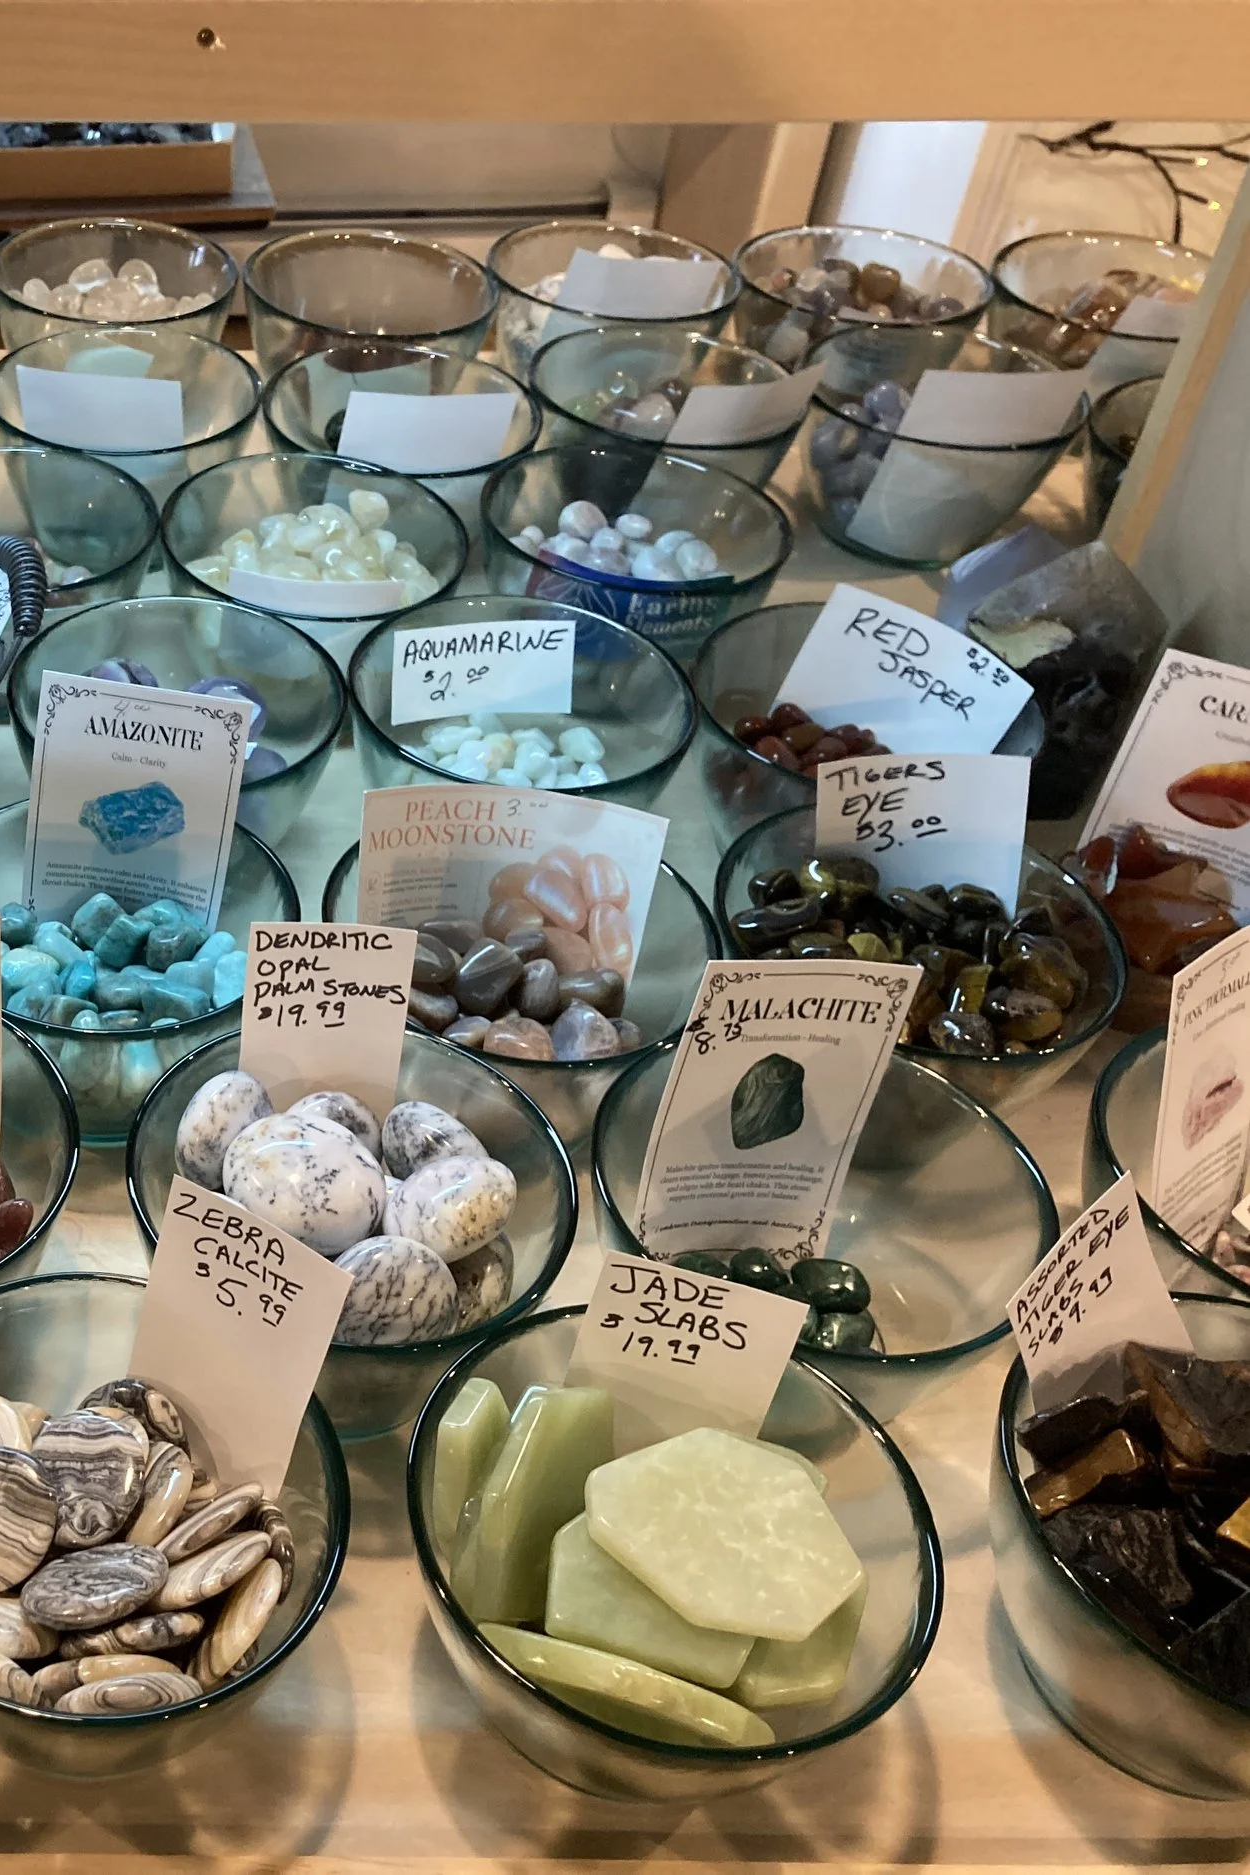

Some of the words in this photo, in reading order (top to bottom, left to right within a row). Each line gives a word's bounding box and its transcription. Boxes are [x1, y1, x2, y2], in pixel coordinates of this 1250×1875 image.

[403, 628, 569, 669] AQUAMARINE
[844, 607, 931, 657] RED
[877, 649, 976, 721] JASPER
[84, 715, 204, 752] AMAZONITE
[111, 751, 133, 764] Calm
[139, 756, 167, 769] Clarity
[824, 760, 947, 792] TIGERS
[405, 799, 497, 823] PEACH
[841, 787, 910, 826] EYE
[368, 824, 537, 852] MOONSTONE
[255, 930, 393, 952] DENDRITIC
[257, 955, 331, 982] OPAL
[253, 977, 315, 1007] PALM
[323, 978, 407, 1005] STONES
[719, 997, 883, 1025] MALACHITE
[741, 1033, 801, 1044] Transformation
[808, 1034, 841, 1046] Healing
[173, 1192, 286, 1266] ZEBRA
[194, 1236, 304, 1302] CALCITE
[1016, 1208, 1110, 1324] ASSORTED
[1020, 1258, 1083, 1335] TIGER
[1088, 1204, 1130, 1258] EYE
[610, 1263, 731, 1310] JADE
[634, 1301, 748, 1350] SLABS
[1028, 1277, 1084, 1358] SLABS
